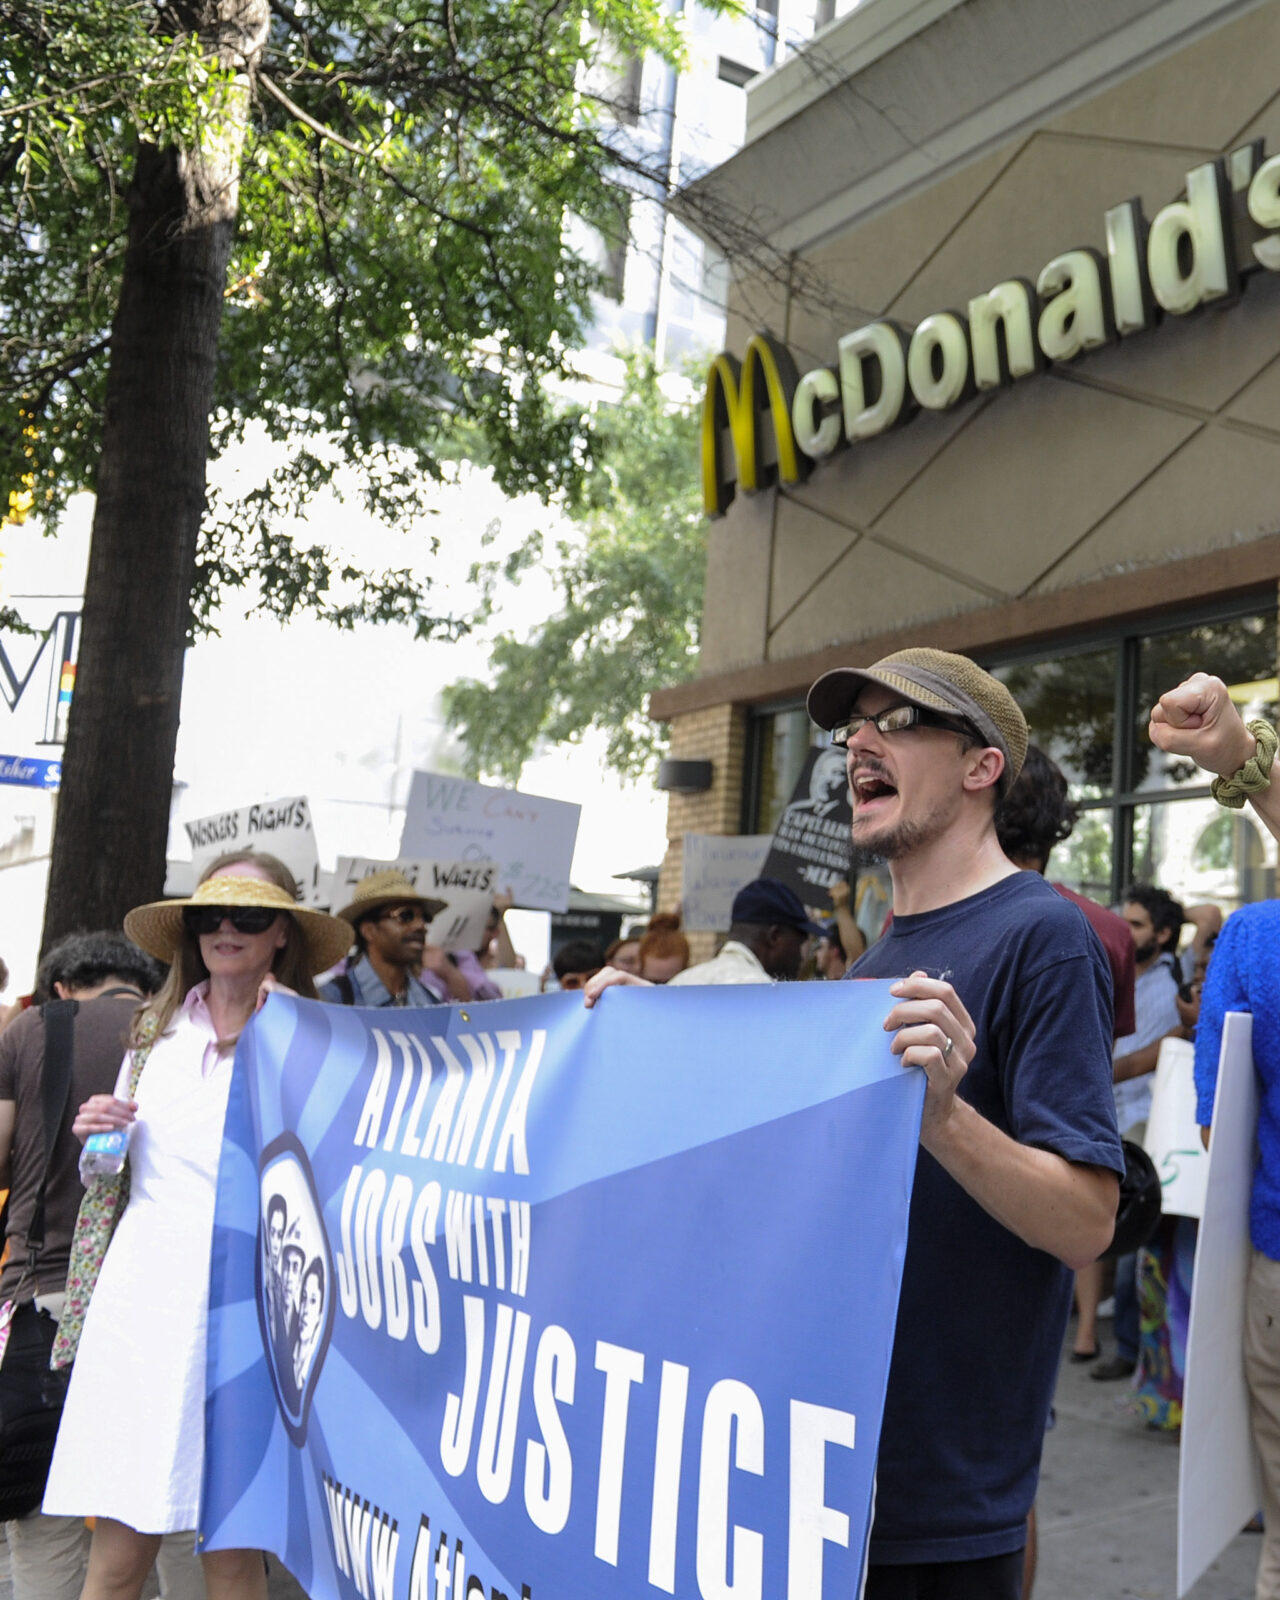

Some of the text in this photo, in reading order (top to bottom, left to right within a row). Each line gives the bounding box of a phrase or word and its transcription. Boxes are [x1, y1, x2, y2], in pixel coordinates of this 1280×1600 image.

[425, 777, 474, 813] WE
[353, 1027, 548, 1176] ATLANTA
[336, 1163, 532, 1356] JOBS WITH
[439, 1293, 856, 1600] JUSTICE
